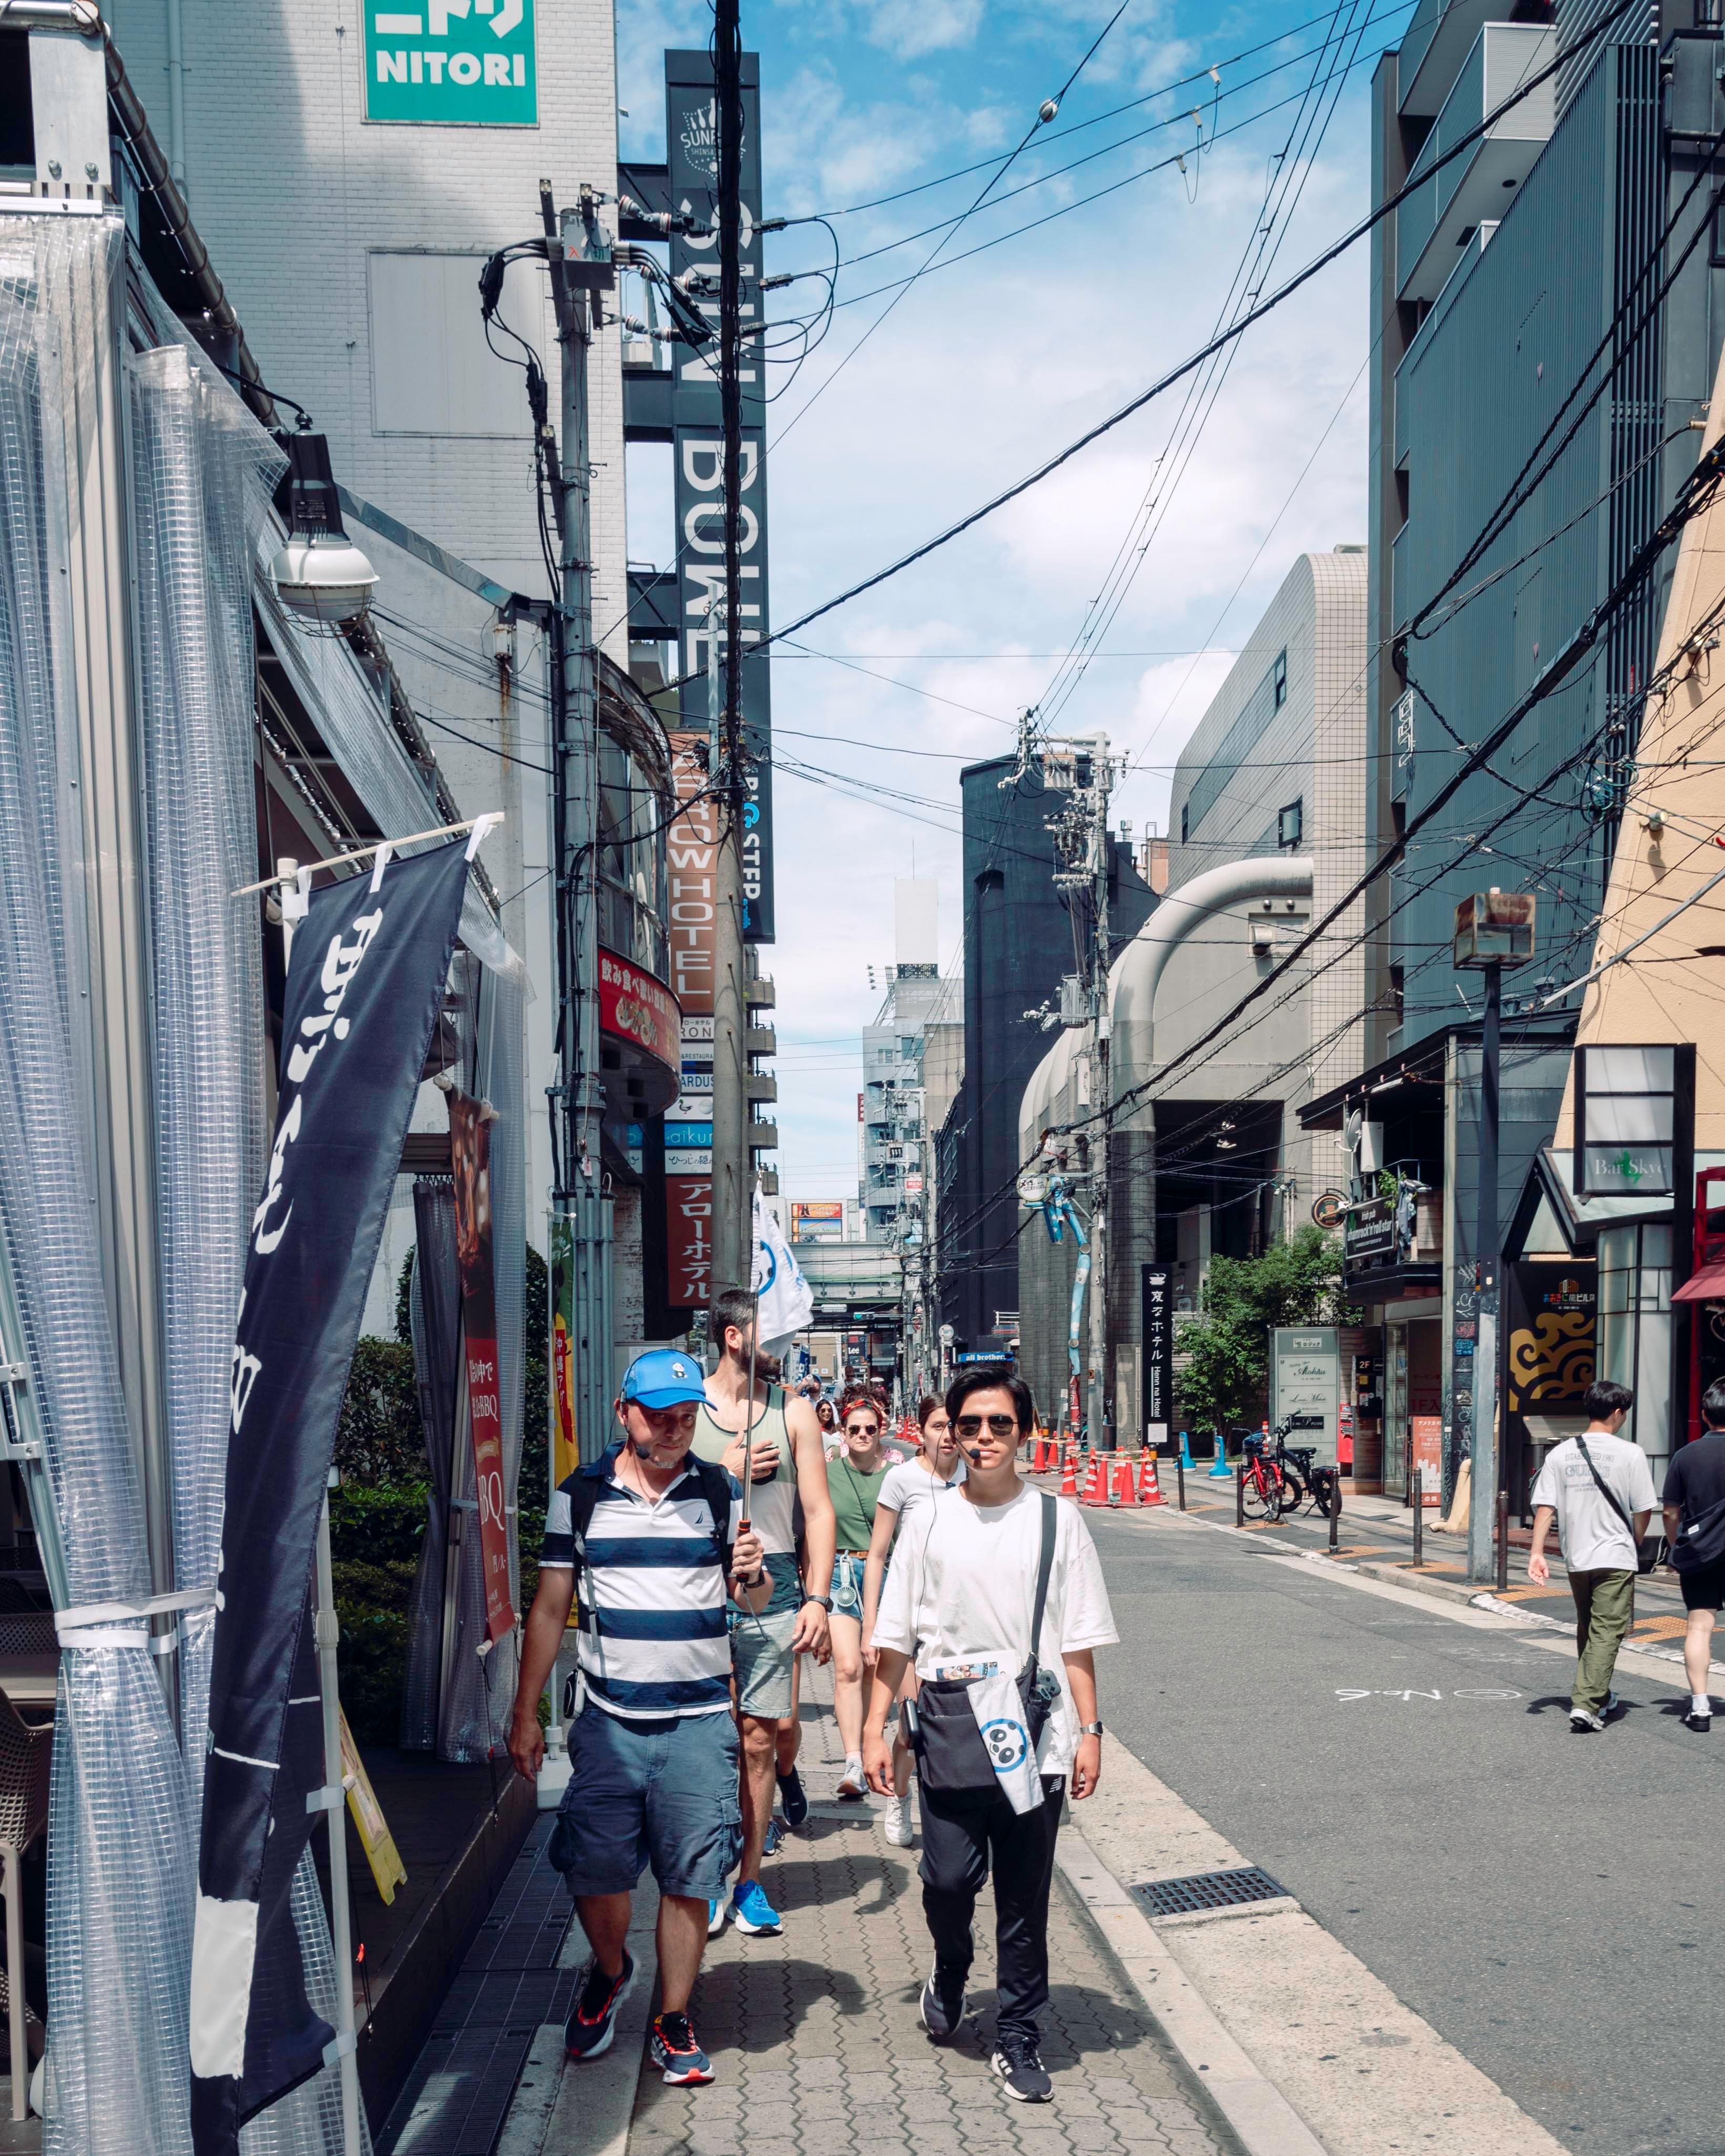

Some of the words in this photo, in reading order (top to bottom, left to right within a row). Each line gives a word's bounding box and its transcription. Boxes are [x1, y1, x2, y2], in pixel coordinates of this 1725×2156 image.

[376, 50, 526, 86] NITORI
[672, 878, 713, 994] HOTEL
[1595, 1159, 1624, 1175] Bar
[679, 1183, 712, 1300] アローホテル
[1151, 1291, 1163, 1360] 変なホテル
[1359, 1361, 1371, 1369] 2F
